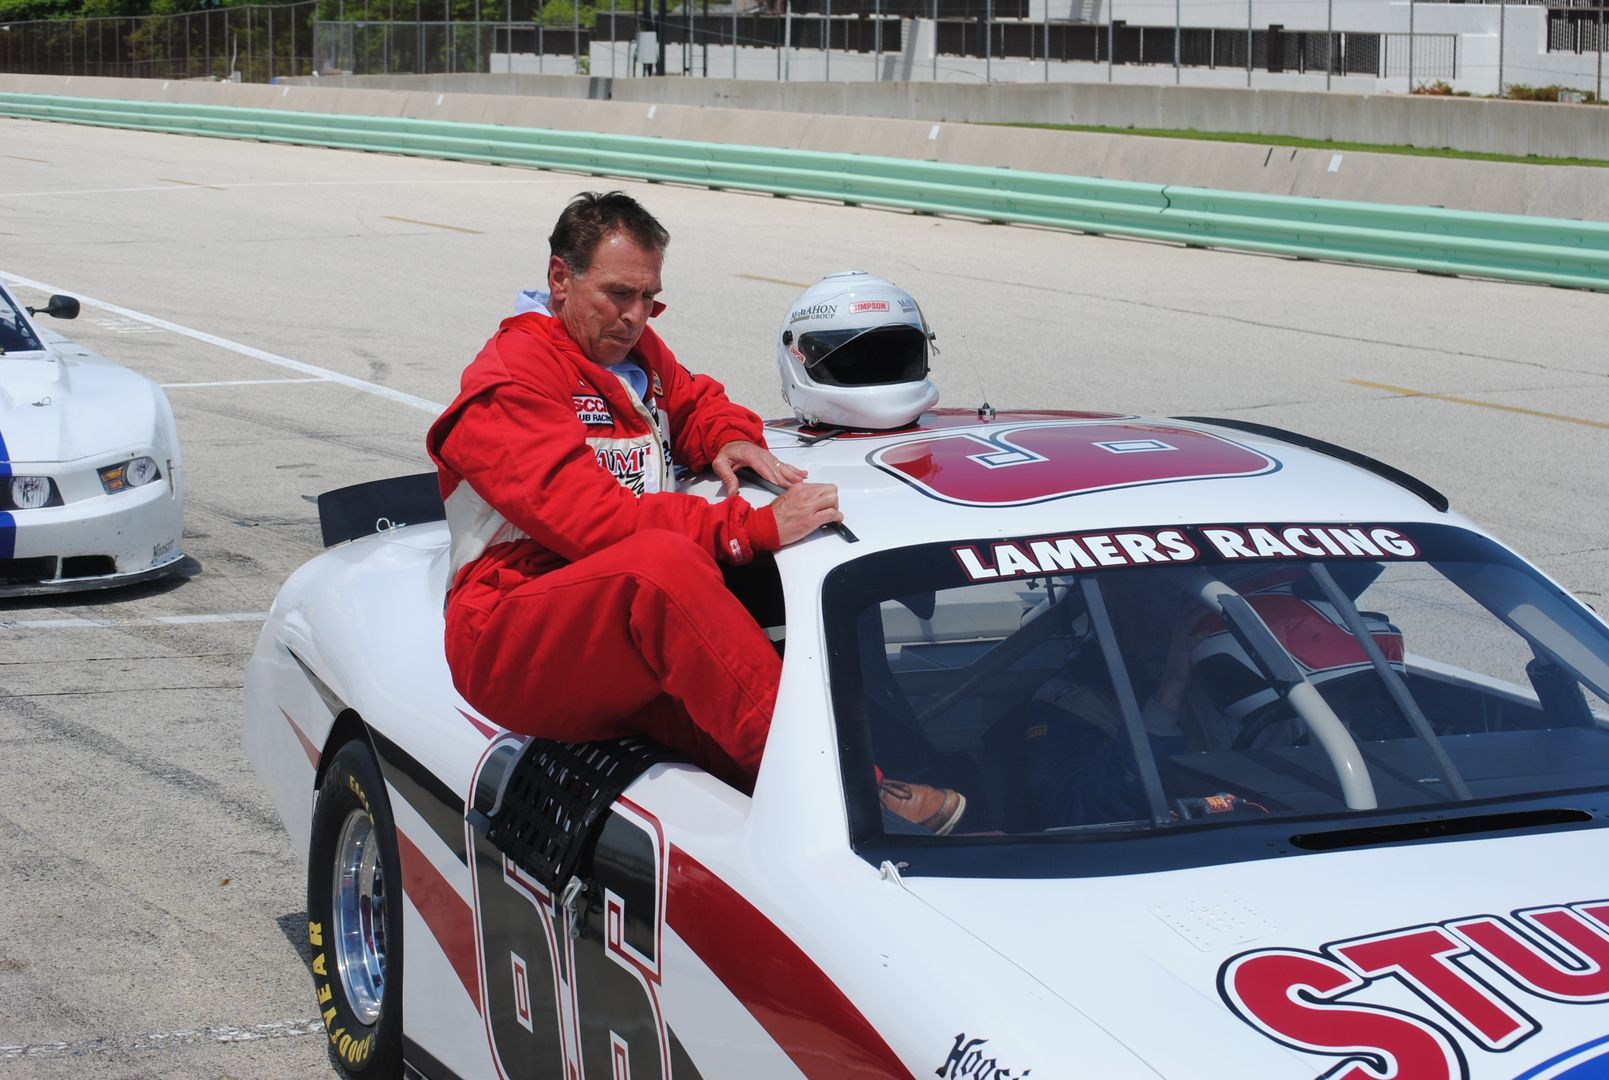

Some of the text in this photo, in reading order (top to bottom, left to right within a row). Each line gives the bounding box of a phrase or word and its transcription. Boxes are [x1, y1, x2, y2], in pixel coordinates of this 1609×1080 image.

[852, 302, 886, 312] SIMPSON
[955, 527, 1417, 580] LAMERS RACING
